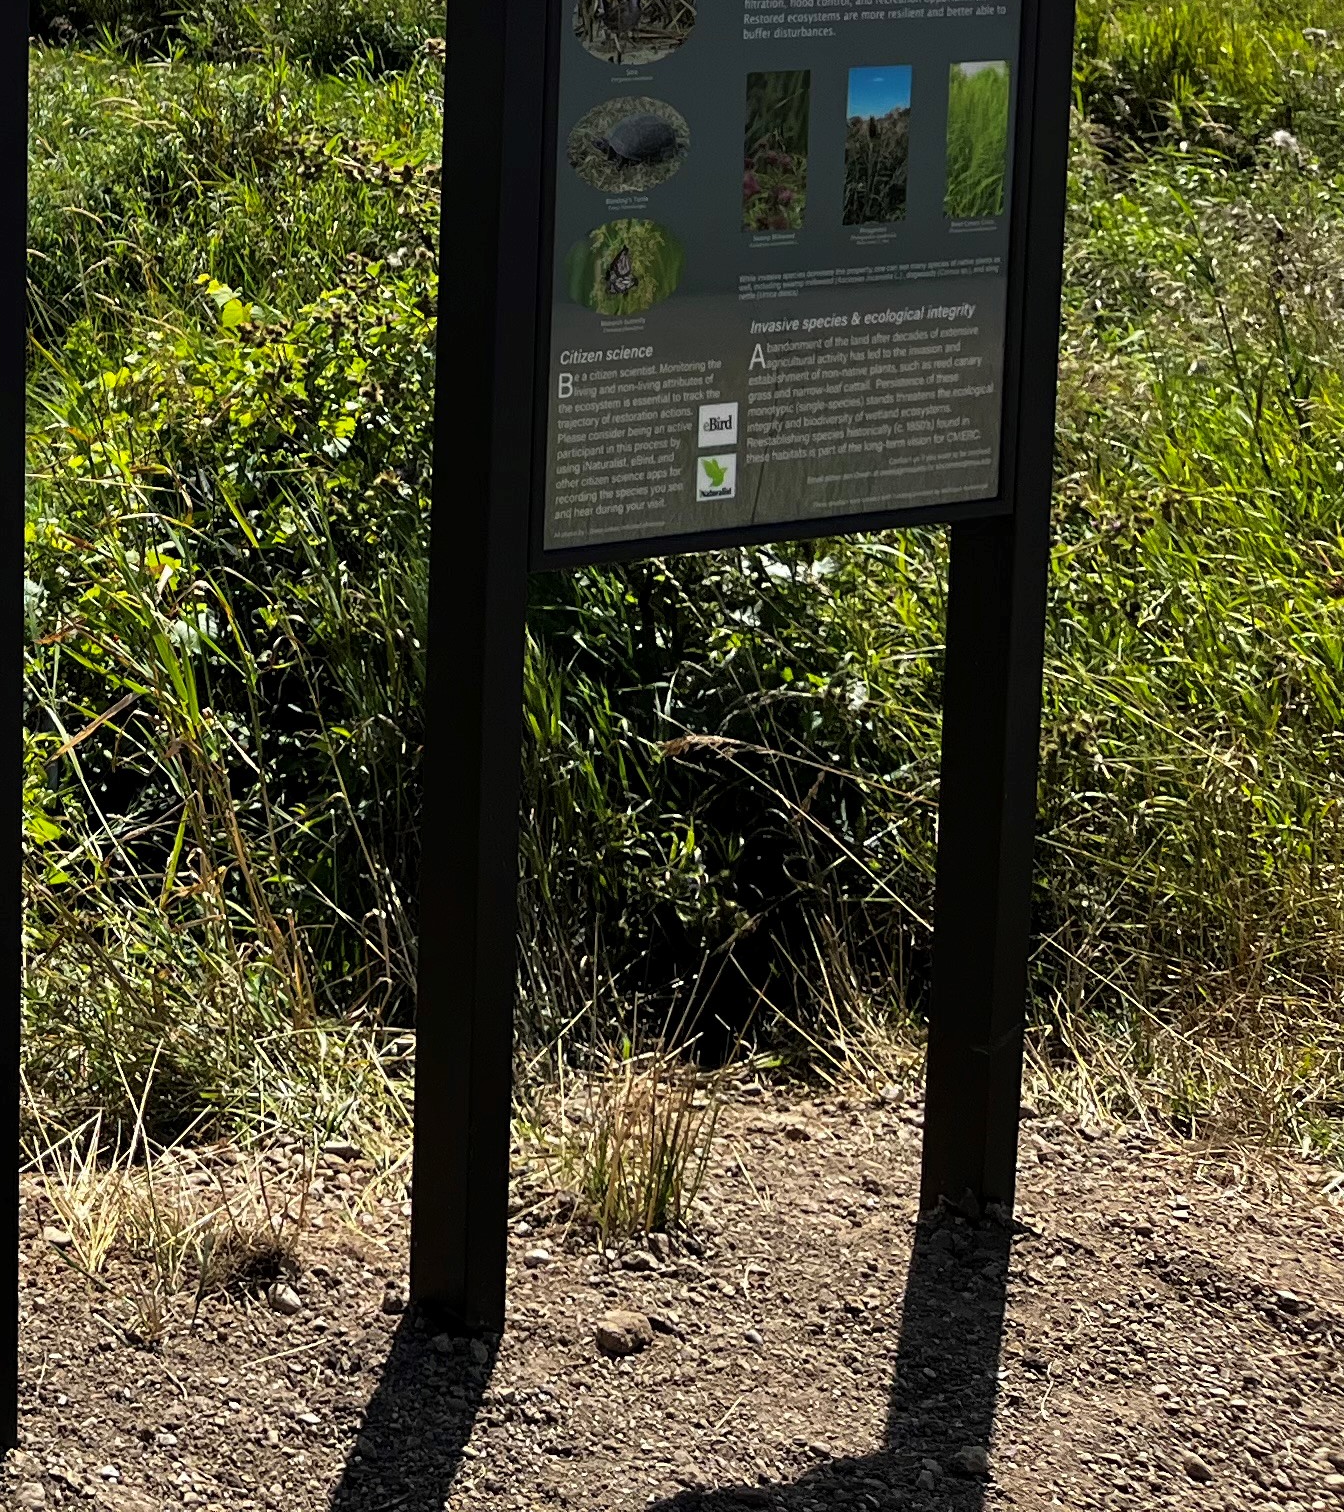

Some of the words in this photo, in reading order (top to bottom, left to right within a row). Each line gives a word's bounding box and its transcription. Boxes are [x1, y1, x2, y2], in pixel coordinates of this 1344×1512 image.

[742, 26, 771, 40] buffer
[749, 315, 800, 334] Invasive
[801, 311, 848, 334] species
[850, 310, 861, 327] &
[863, 305, 924, 328] ecological
[926, 302, 975, 324] integrity
[559, 347, 603, 366] Citizen
[605, 344, 653, 362] science
[703, 414, 732, 432] eBird
